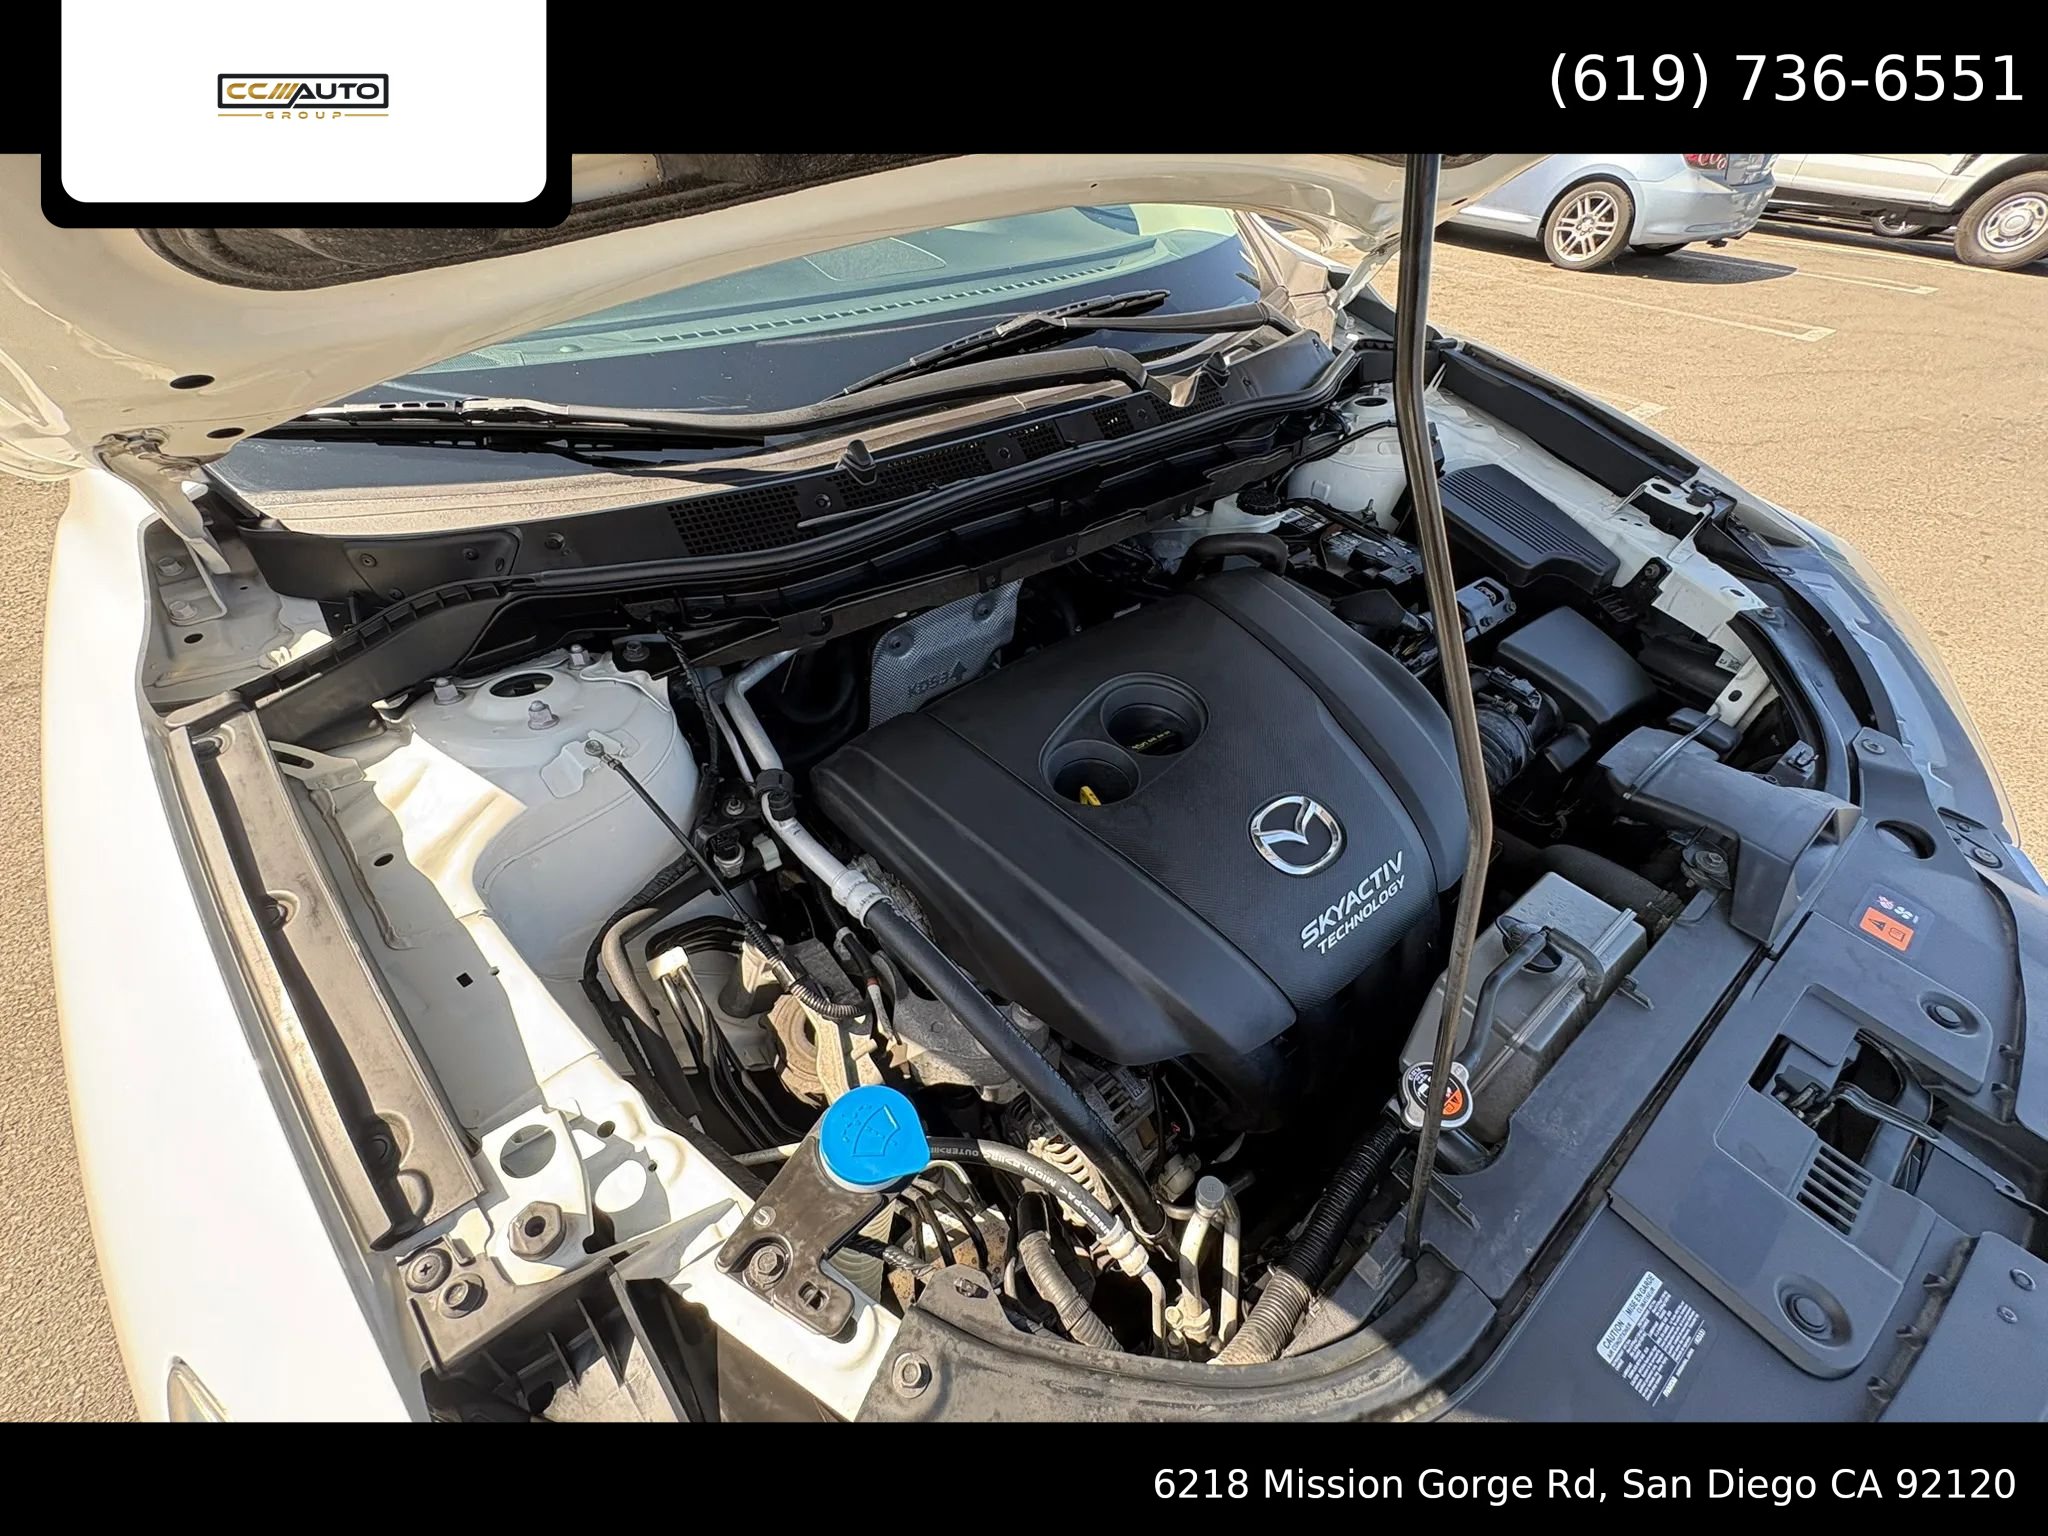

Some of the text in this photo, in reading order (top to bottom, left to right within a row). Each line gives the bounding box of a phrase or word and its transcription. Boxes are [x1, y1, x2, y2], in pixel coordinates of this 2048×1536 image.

[1300, 850, 1402, 949] SKYACTIV
[1316, 875, 1405, 954] TECHNOLOGY
[1640, 1274, 1655, 1295] GARDE
[1602, 1319, 1625, 1349] CAUTION
